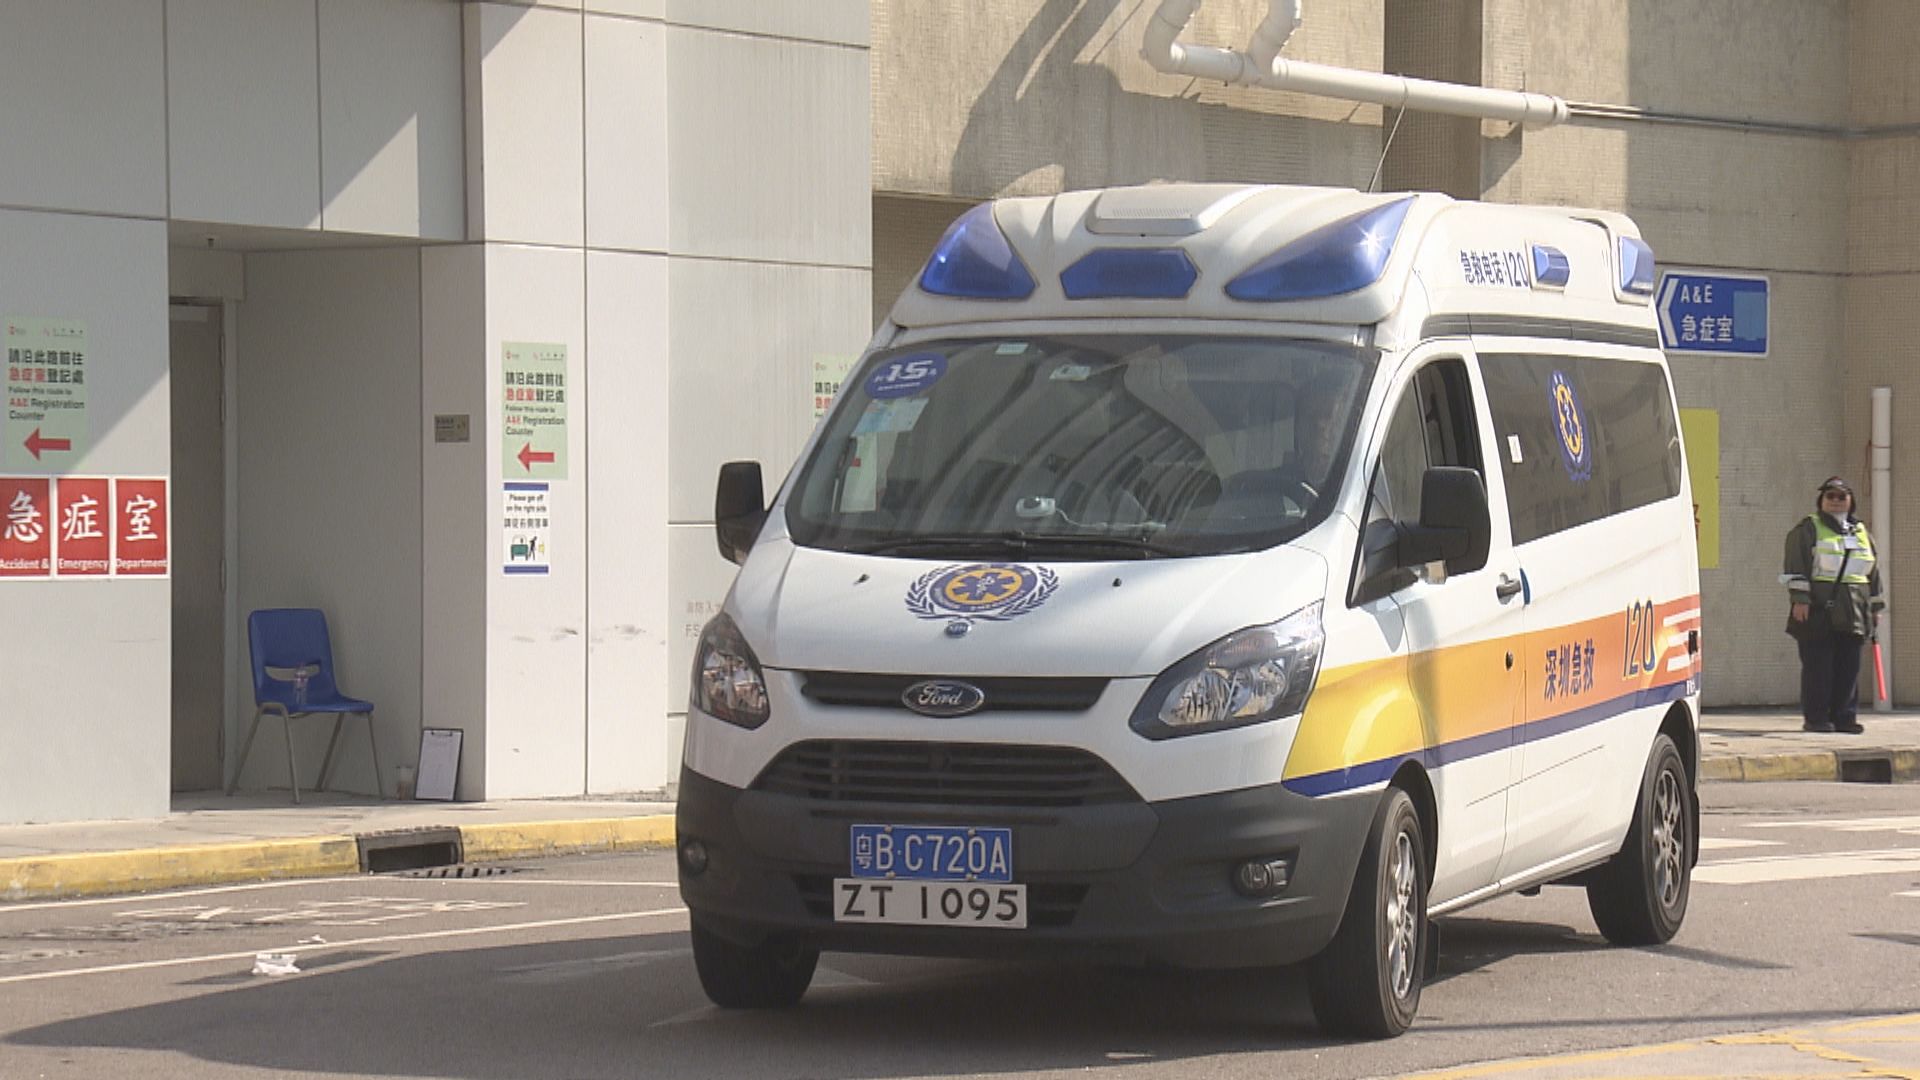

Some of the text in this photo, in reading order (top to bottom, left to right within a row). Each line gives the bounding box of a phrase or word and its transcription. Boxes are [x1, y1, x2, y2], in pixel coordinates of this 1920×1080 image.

[1681, 284, 1713, 303] A&E
[1682, 314, 1733, 342] 急症室
[31, 398, 85, 410] Registration
[9, 410, 45, 420] Counter
[523, 416, 565, 427] Registration
[505, 426, 533, 436] Counter
[4, 490, 158, 542] 急症室
[59, 559, 109, 571] Emergency
[116, 559, 167, 571] Department
[1622, 598, 1657, 678] 120
[1544, 638, 1595, 702] 深圳急救
[918, 683, 963, 706] Ford
[841, 883, 1019, 922] ZT 1095
